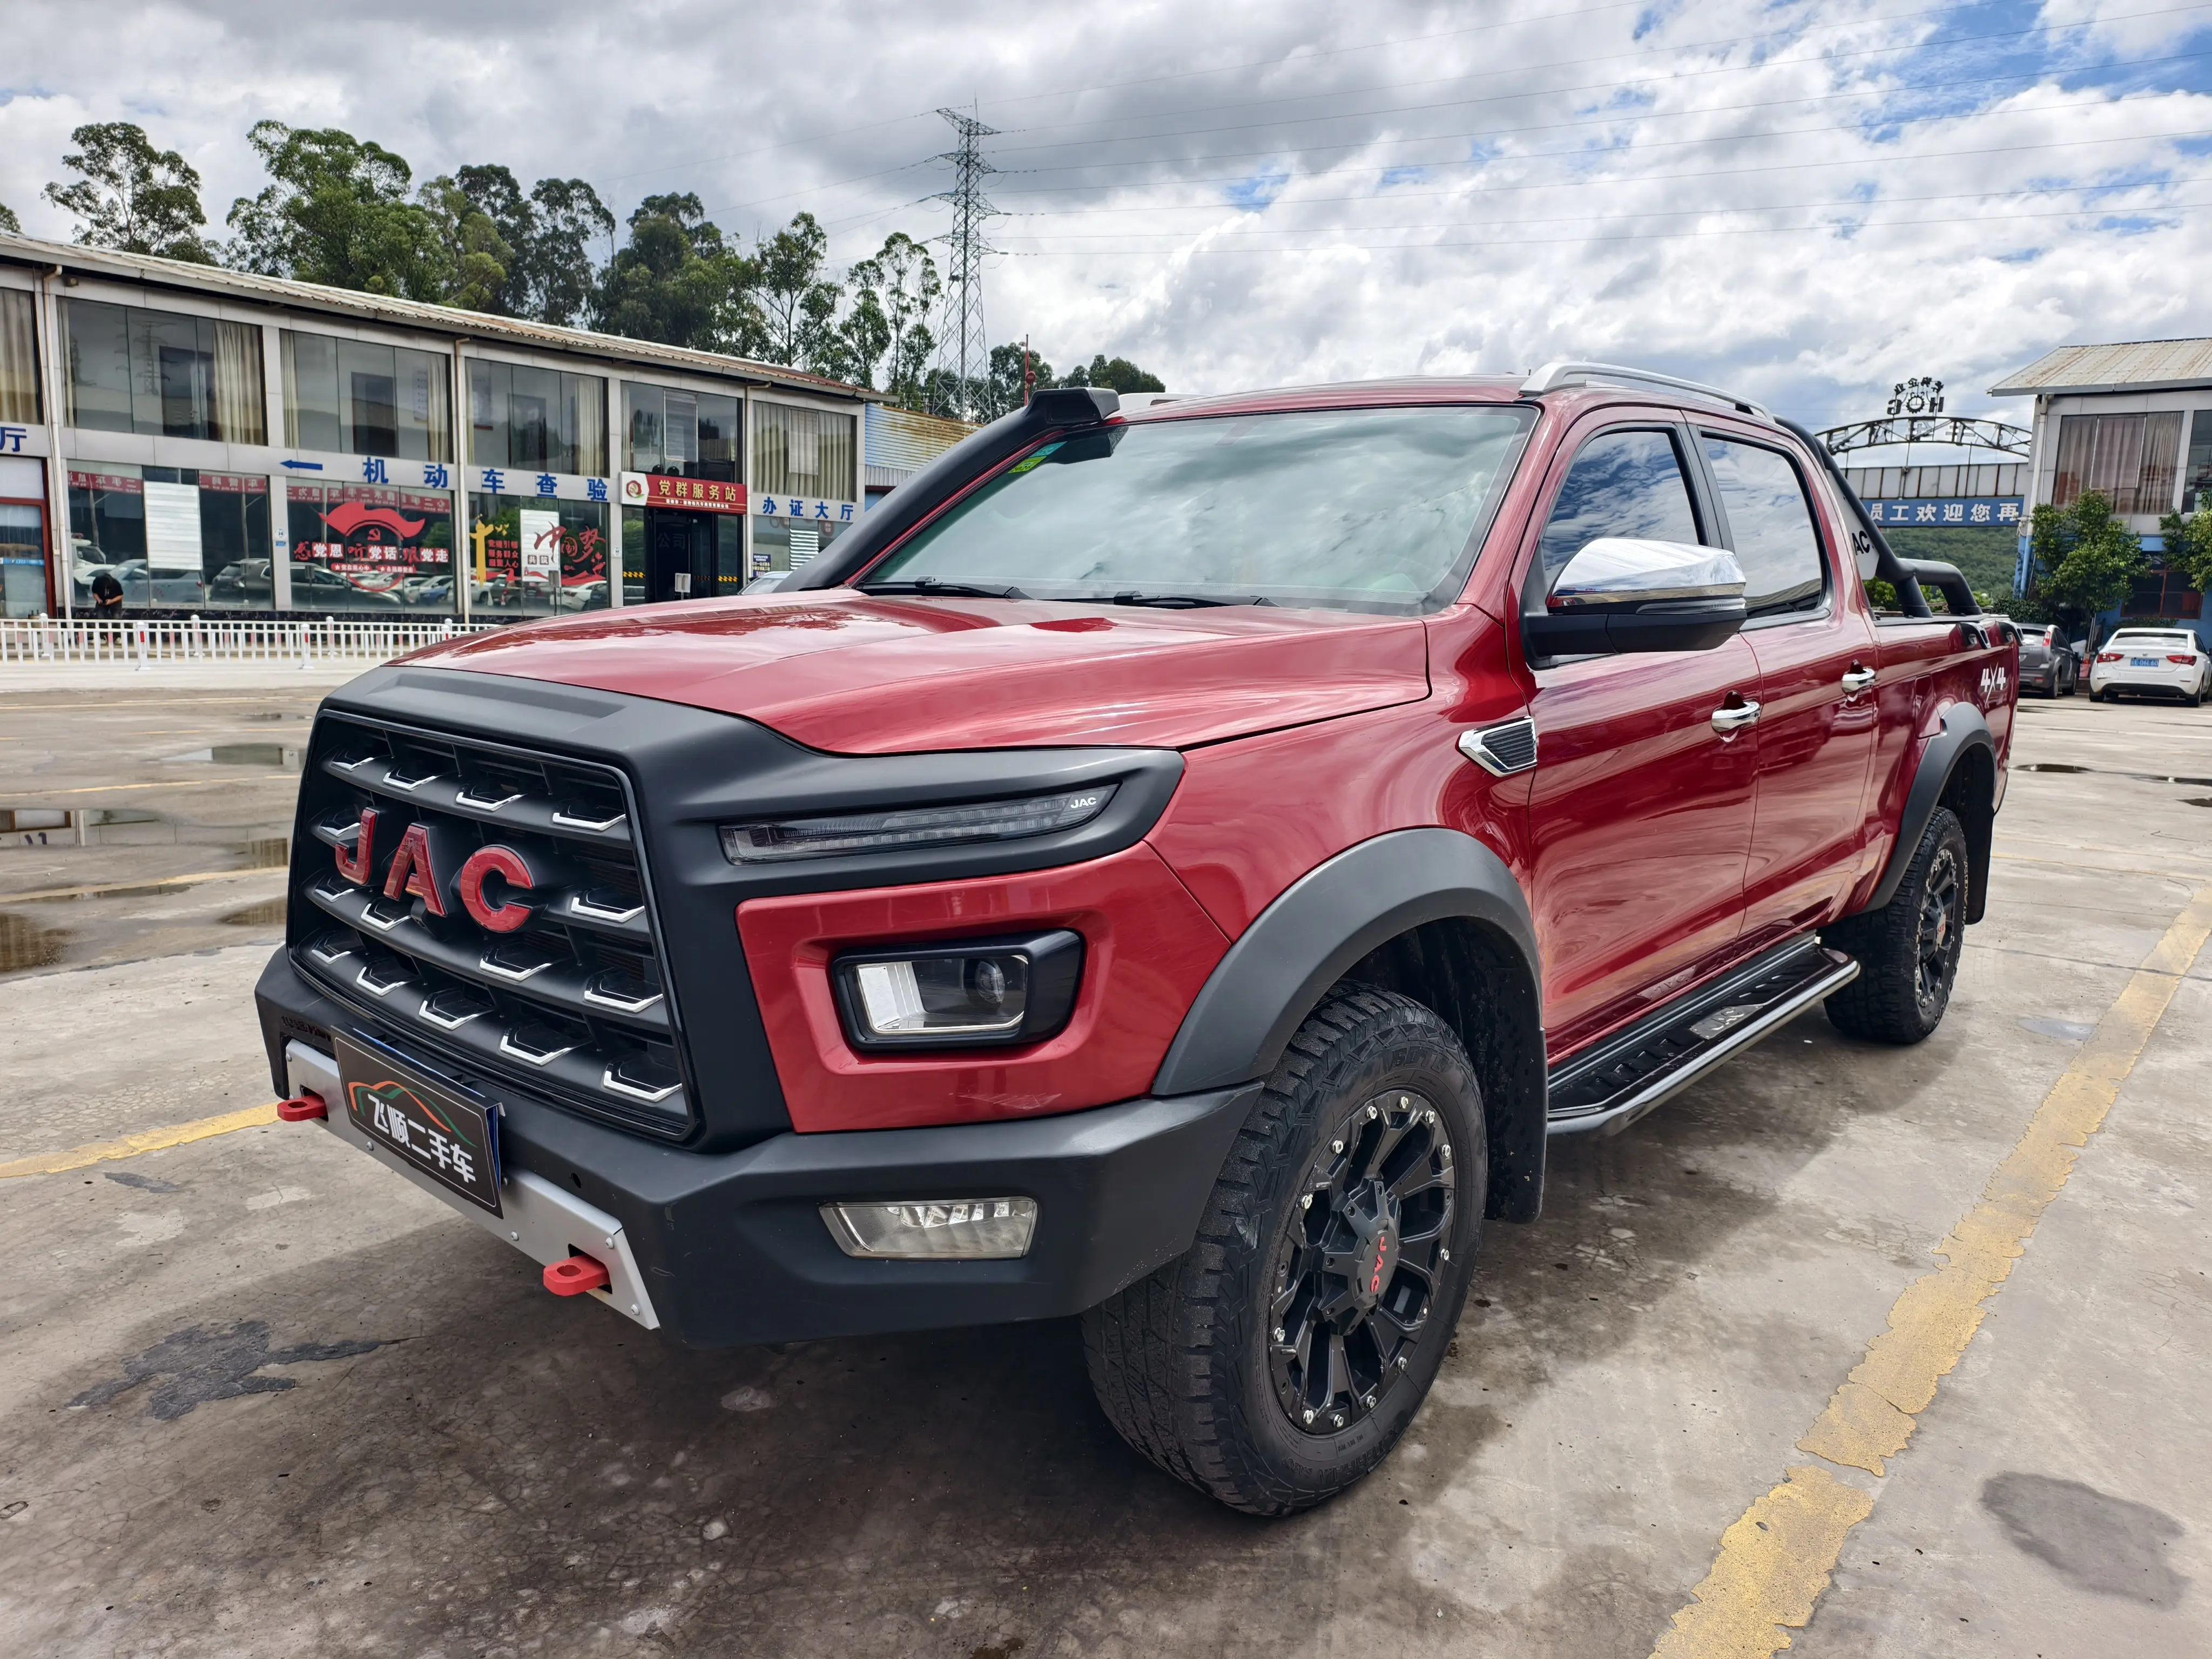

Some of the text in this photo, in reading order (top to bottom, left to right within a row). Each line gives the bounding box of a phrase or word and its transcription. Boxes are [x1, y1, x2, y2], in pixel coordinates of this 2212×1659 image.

[0, 427, 27, 452] 厅
[363, 457, 608, 501] 机动车查验
[659, 480, 736, 502] 党群服务站
[763, 496, 854, 521] 办证大厅
[1870, 502, 2019, 523] 员工欢迎您再
[534, 521, 606, 563] 中国梦
[1851, 530, 1870, 556] AC
[1070, 797, 1097, 808] JAC
[335, 807, 536, 933] JAC
[368, 1093, 476, 1183] 飞顺二手车
[1370, 1236, 1387, 1293] JAC
